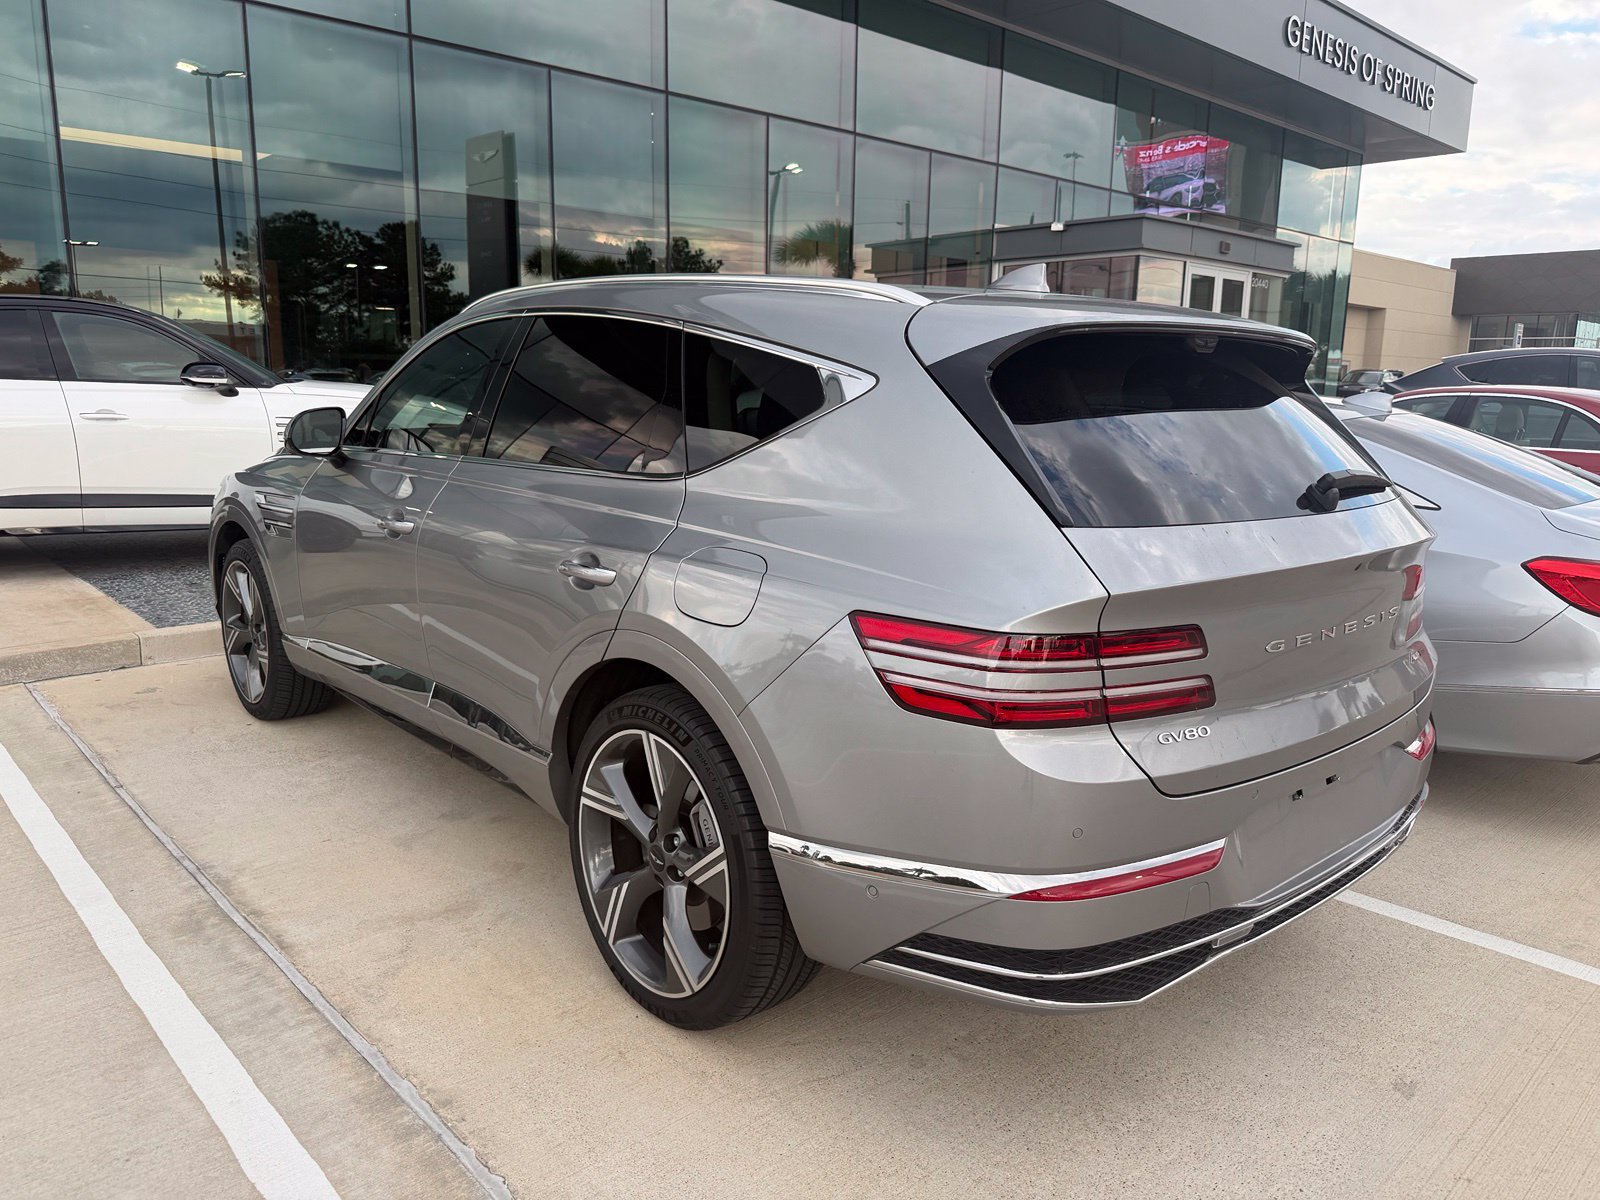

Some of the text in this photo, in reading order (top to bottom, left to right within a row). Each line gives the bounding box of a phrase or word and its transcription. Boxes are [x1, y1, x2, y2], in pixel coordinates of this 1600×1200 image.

[1285, 14, 1436, 111] GENESIS OF SPRING
[1265, 605, 1400, 654] GENESIS
[622, 705, 689, 742] MICHELIN
[1157, 725, 1211, 746] GV80
[694, 748, 718, 783] PRIMACY
